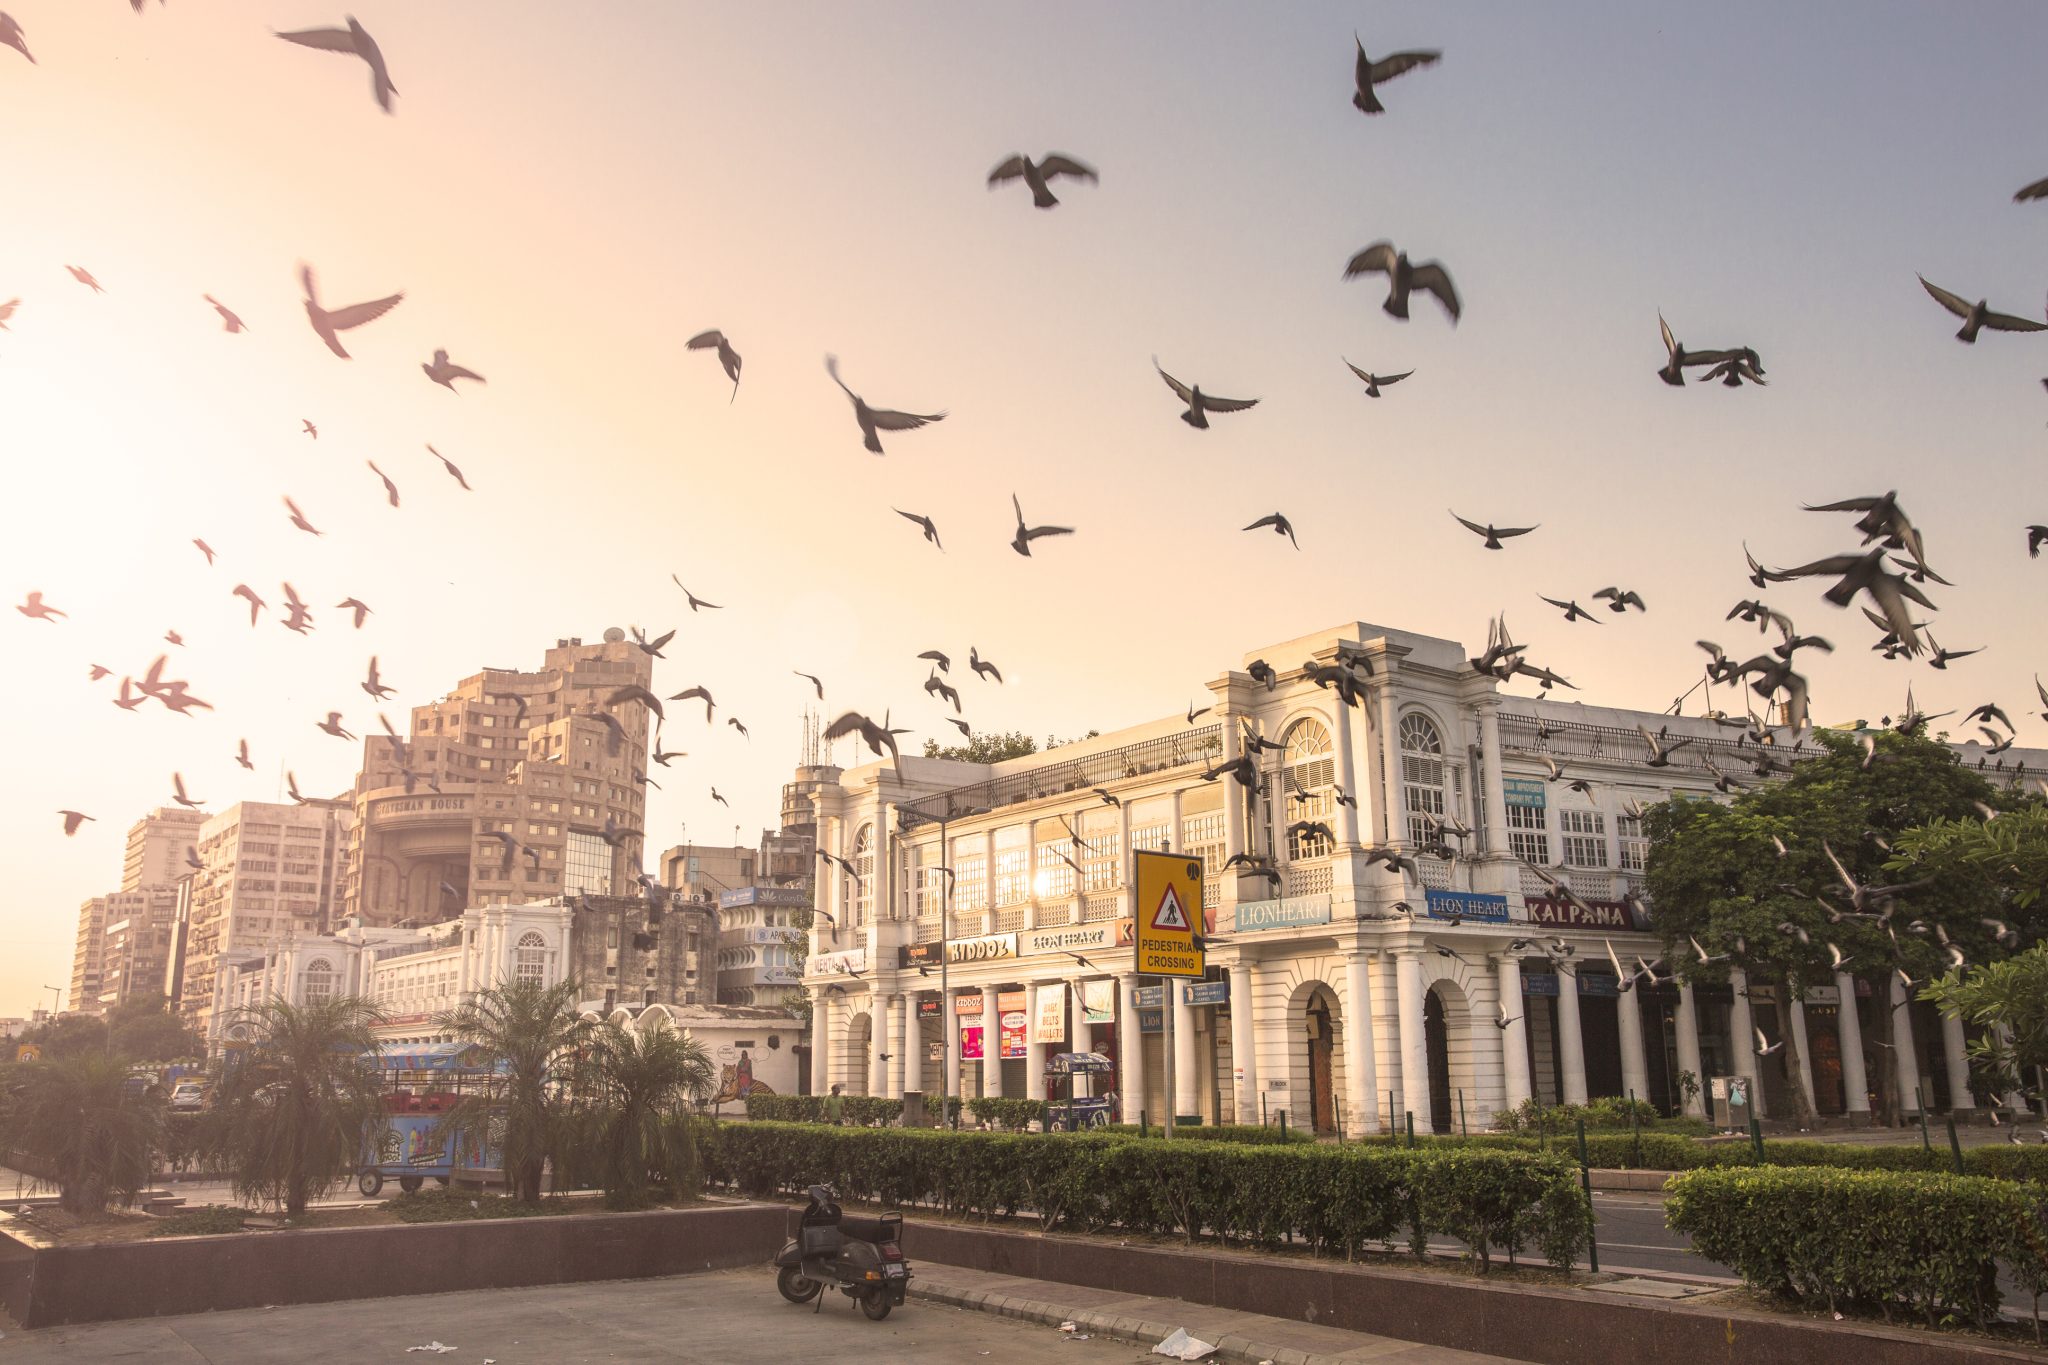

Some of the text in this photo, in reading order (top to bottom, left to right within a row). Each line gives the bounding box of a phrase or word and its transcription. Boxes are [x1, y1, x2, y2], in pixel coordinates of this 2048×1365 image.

[376, 799, 465, 814] STATESMAN HOUSE
[1241, 901, 1321, 925] LIONHEART
[1432, 897, 1506, 915] LION HEART
[1528, 903, 1625, 925] KALPANA
[1064, 930, 1105, 946] HEART
[951, 938, 1009, 961] KIDDOZ
[1147, 955, 1195, 969] CROSSING
[1042, 1015, 1059, 1026] BELTS
[1038, 1028, 1063, 1039] WALLETS
